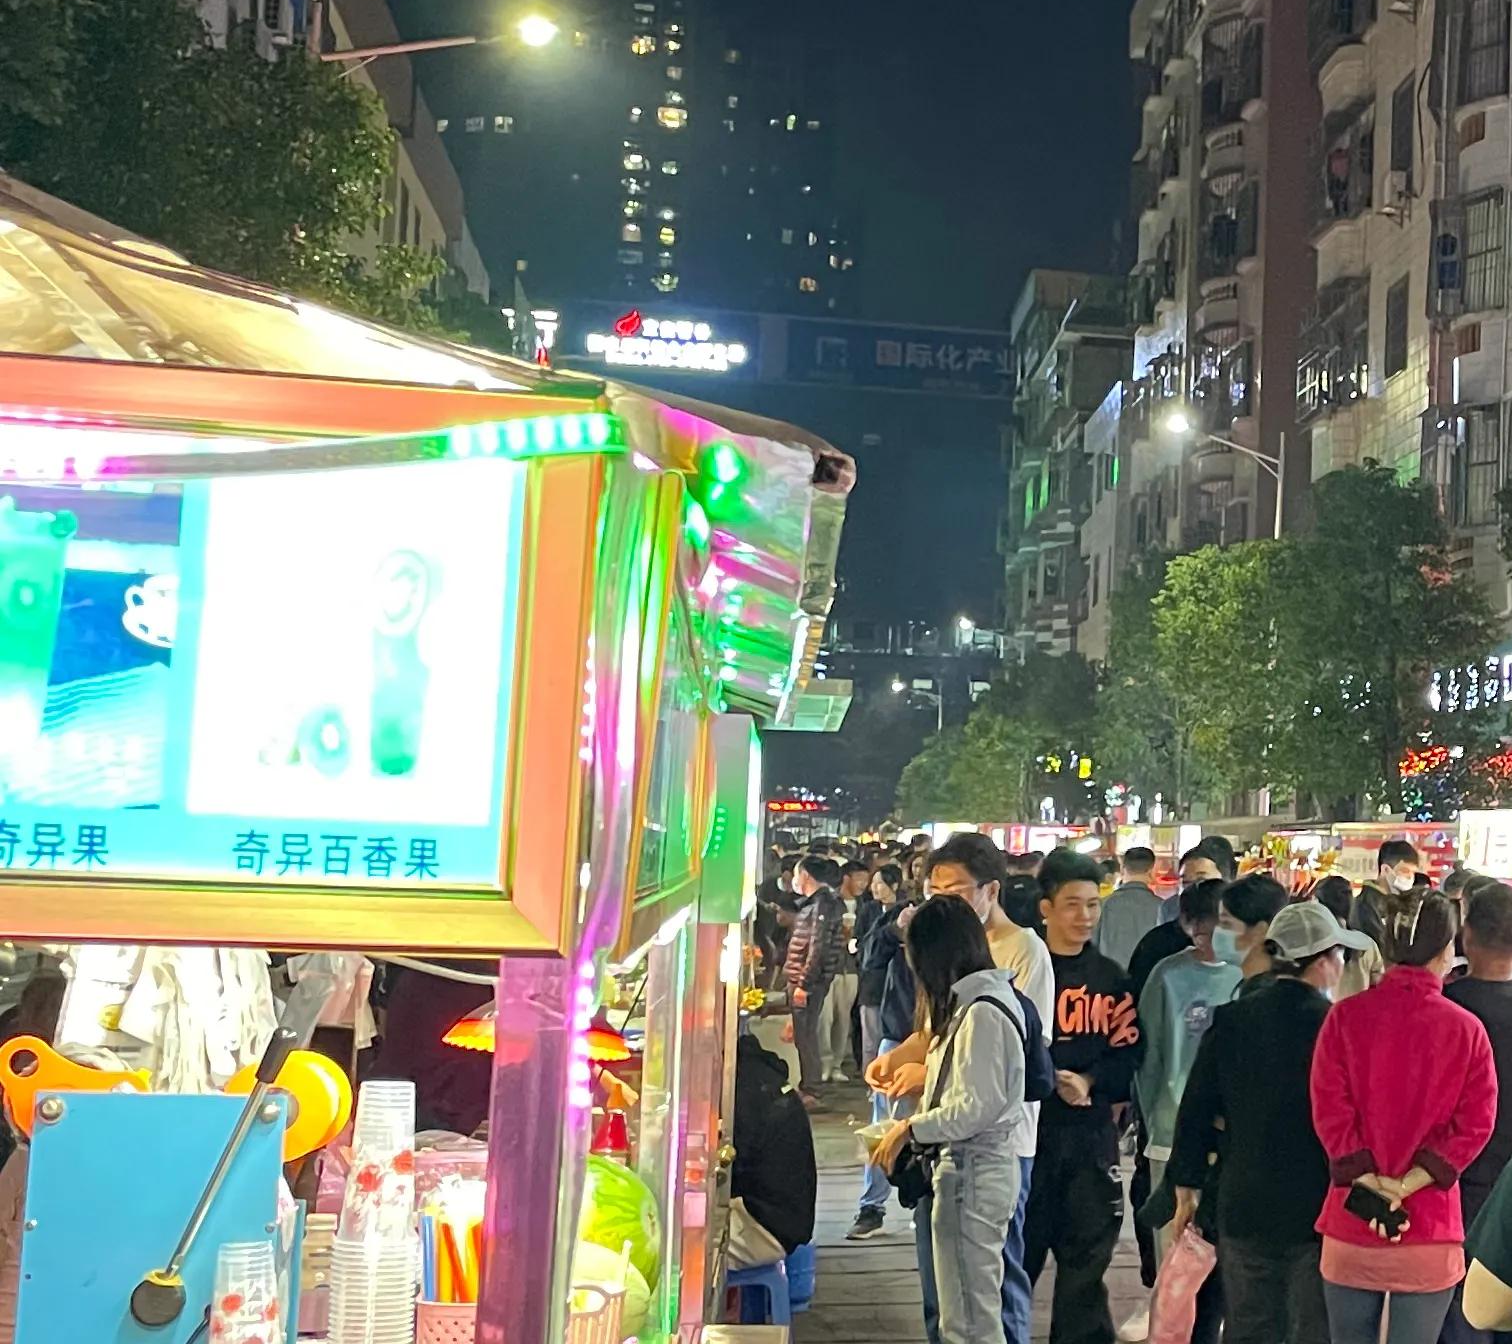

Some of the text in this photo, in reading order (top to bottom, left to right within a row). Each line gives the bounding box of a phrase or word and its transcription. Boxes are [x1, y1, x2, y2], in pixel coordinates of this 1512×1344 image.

[231, 829, 441, 880] 奇异百香果
